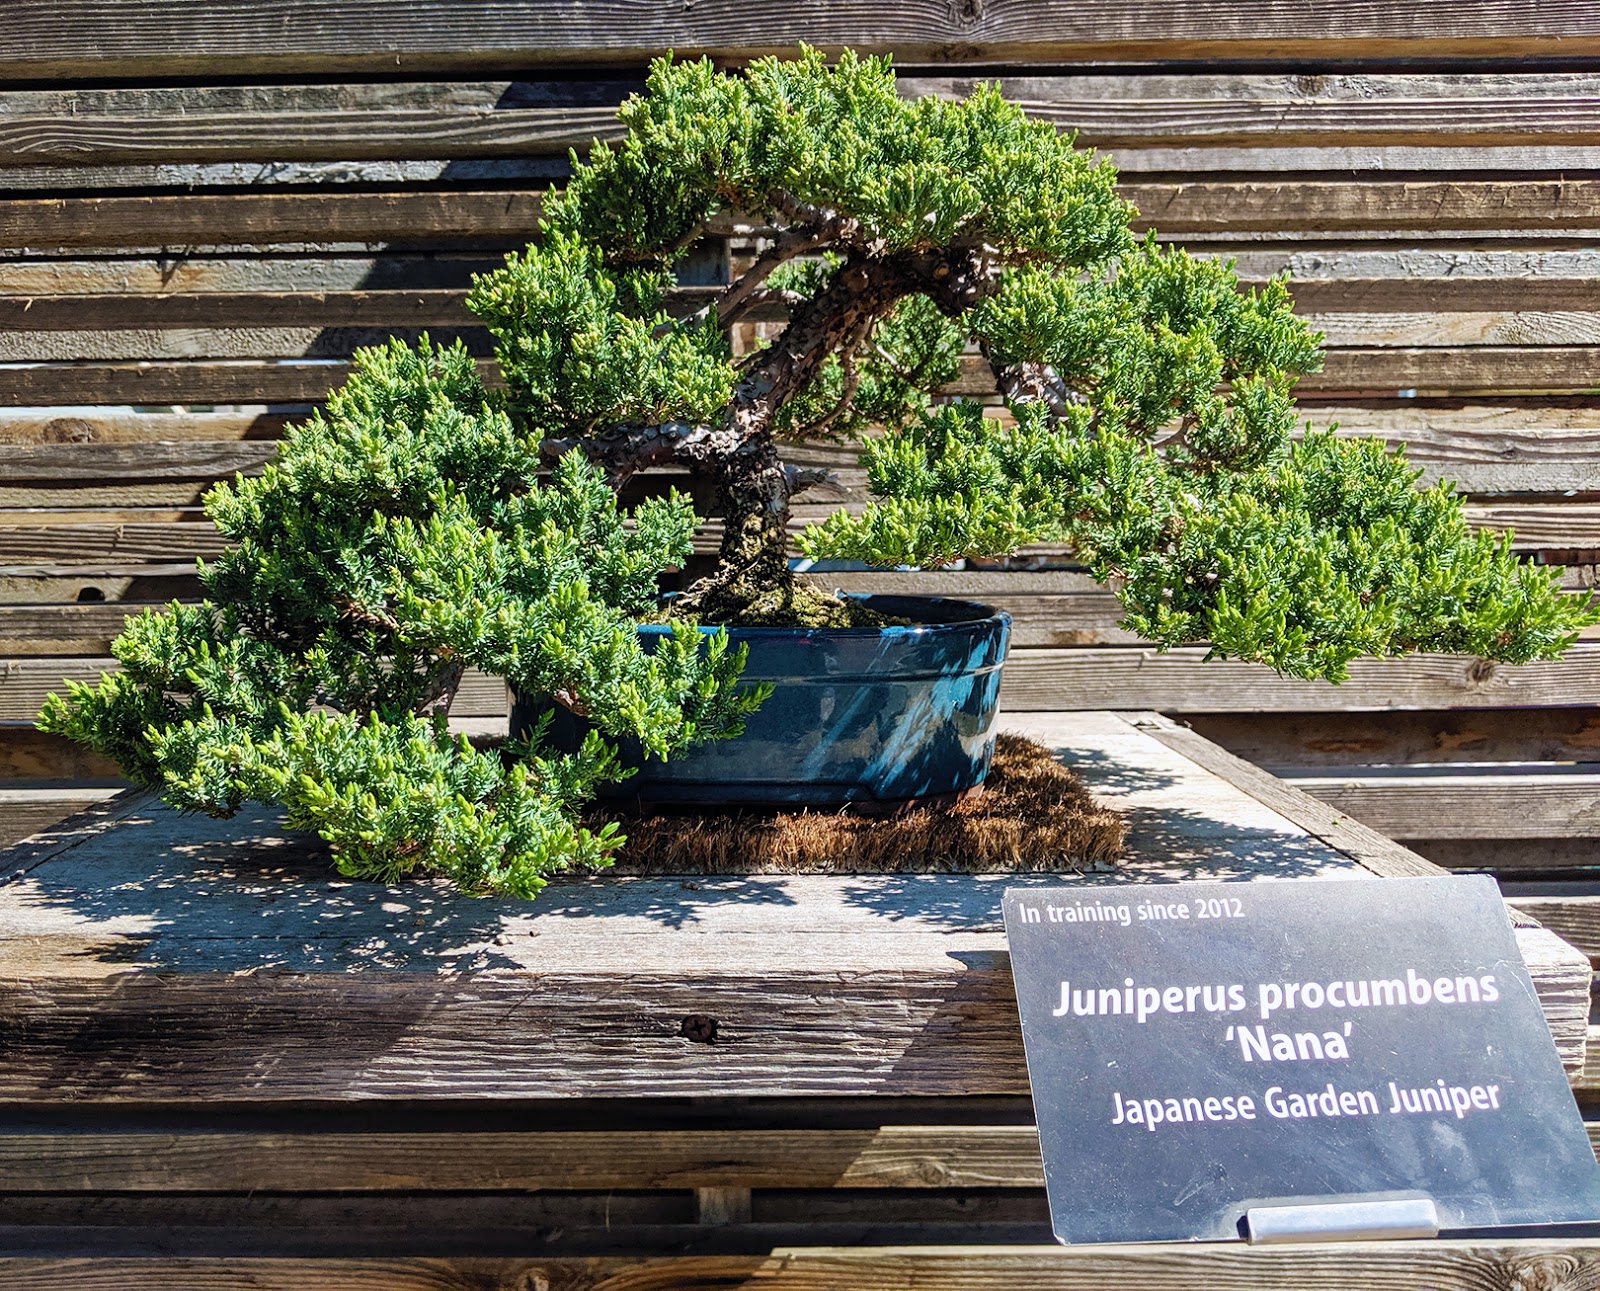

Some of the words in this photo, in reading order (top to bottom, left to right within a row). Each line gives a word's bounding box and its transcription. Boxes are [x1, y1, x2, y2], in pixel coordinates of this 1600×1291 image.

[1019, 902, 1042, 924] In
[1046, 898, 1132, 927] training
[1137, 897, 1190, 921] since
[1196, 897, 1246, 920] 2012
[1052, 977, 1247, 1024] Juniperus
[1258, 968, 1499, 1020] procumbens
[1112, 1092, 1257, 1132] Japanese
[1264, 1083, 1380, 1119] Garden
[1388, 1080, 1500, 1120] Juniper
